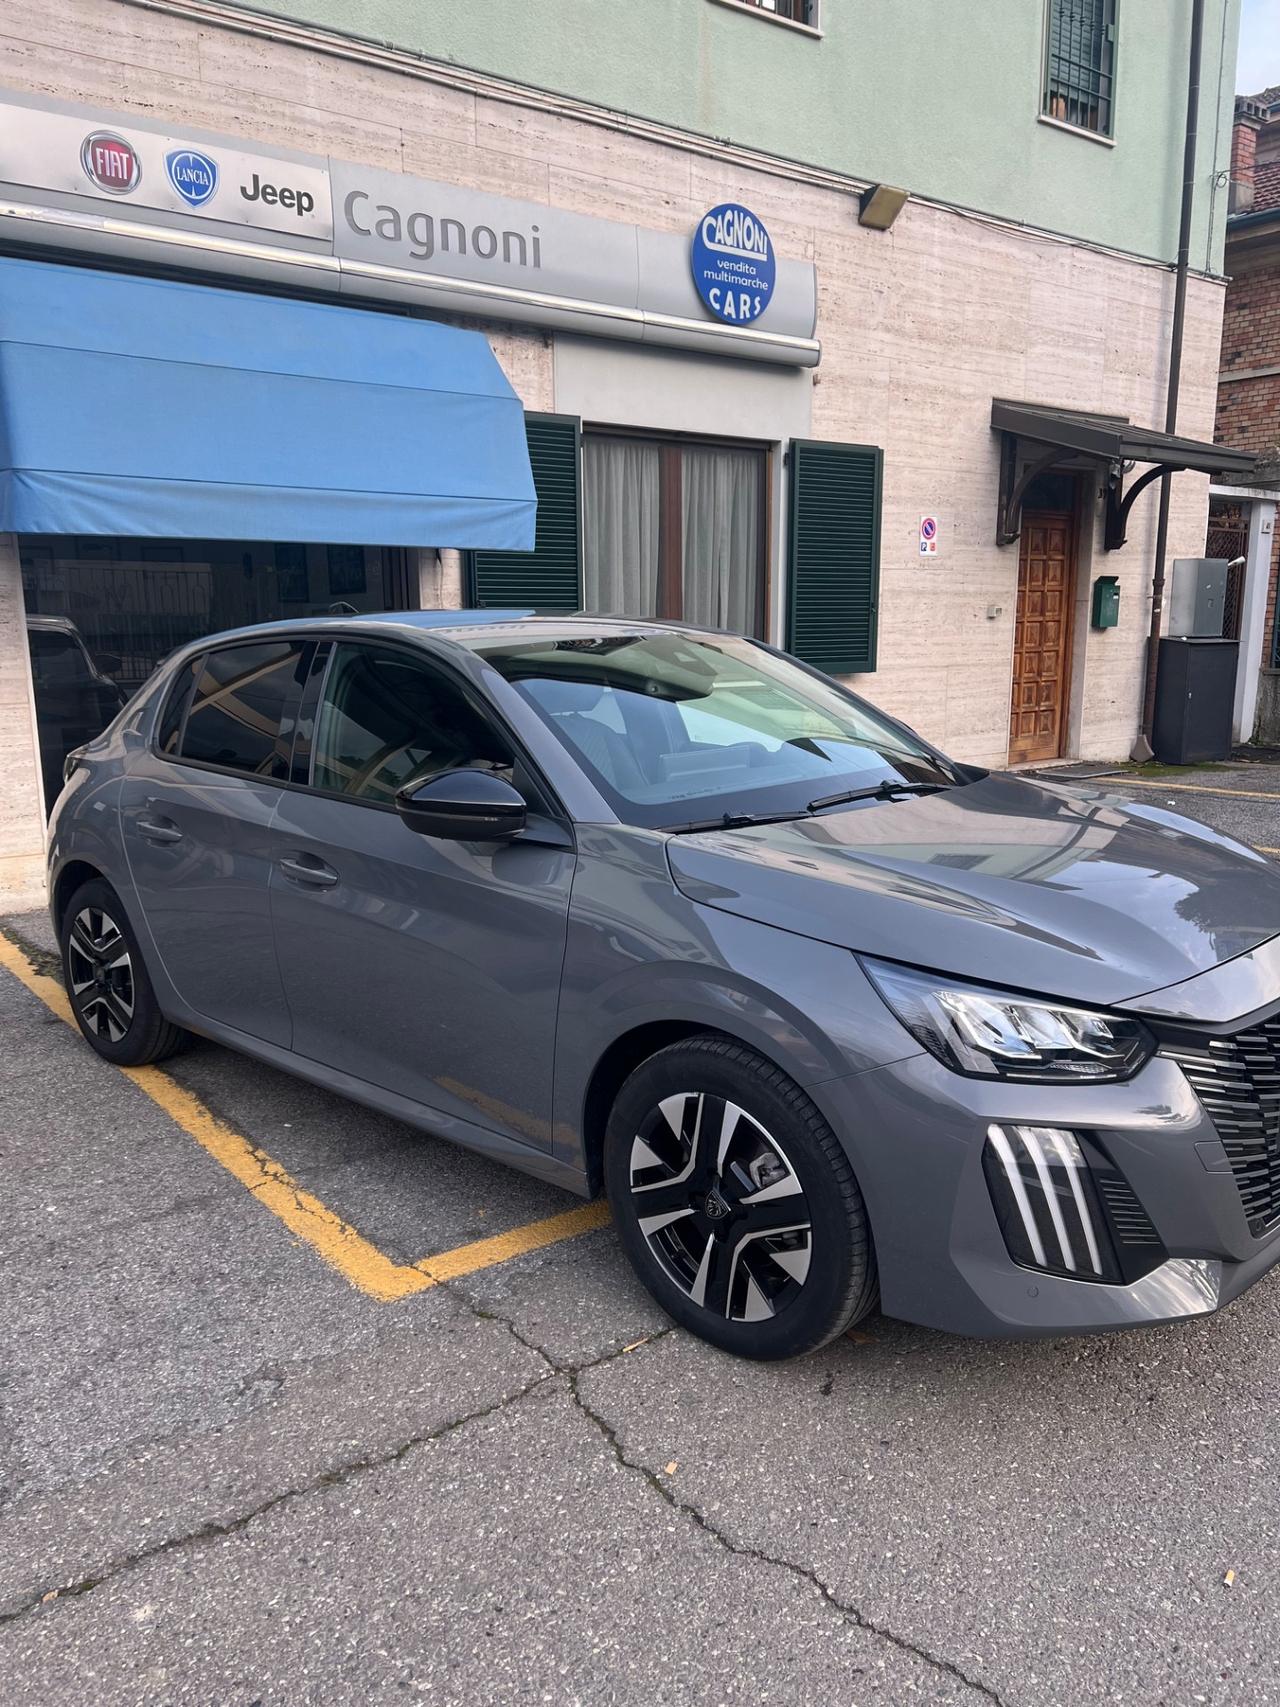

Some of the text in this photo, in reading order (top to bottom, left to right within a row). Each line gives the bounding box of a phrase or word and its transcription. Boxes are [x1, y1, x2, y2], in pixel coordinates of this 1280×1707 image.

[96, 147, 129, 180] FIAT
[176, 166, 209, 186] LANCIA
[240, 173, 314, 216] Jeep
[344, 190, 541, 268] Cagnoni
[702, 210, 767, 261] CAGNONI
[704, 270, 768, 290] multimarche
[717, 259, 756, 275] vendita
[709, 288, 761, 319] CARS
